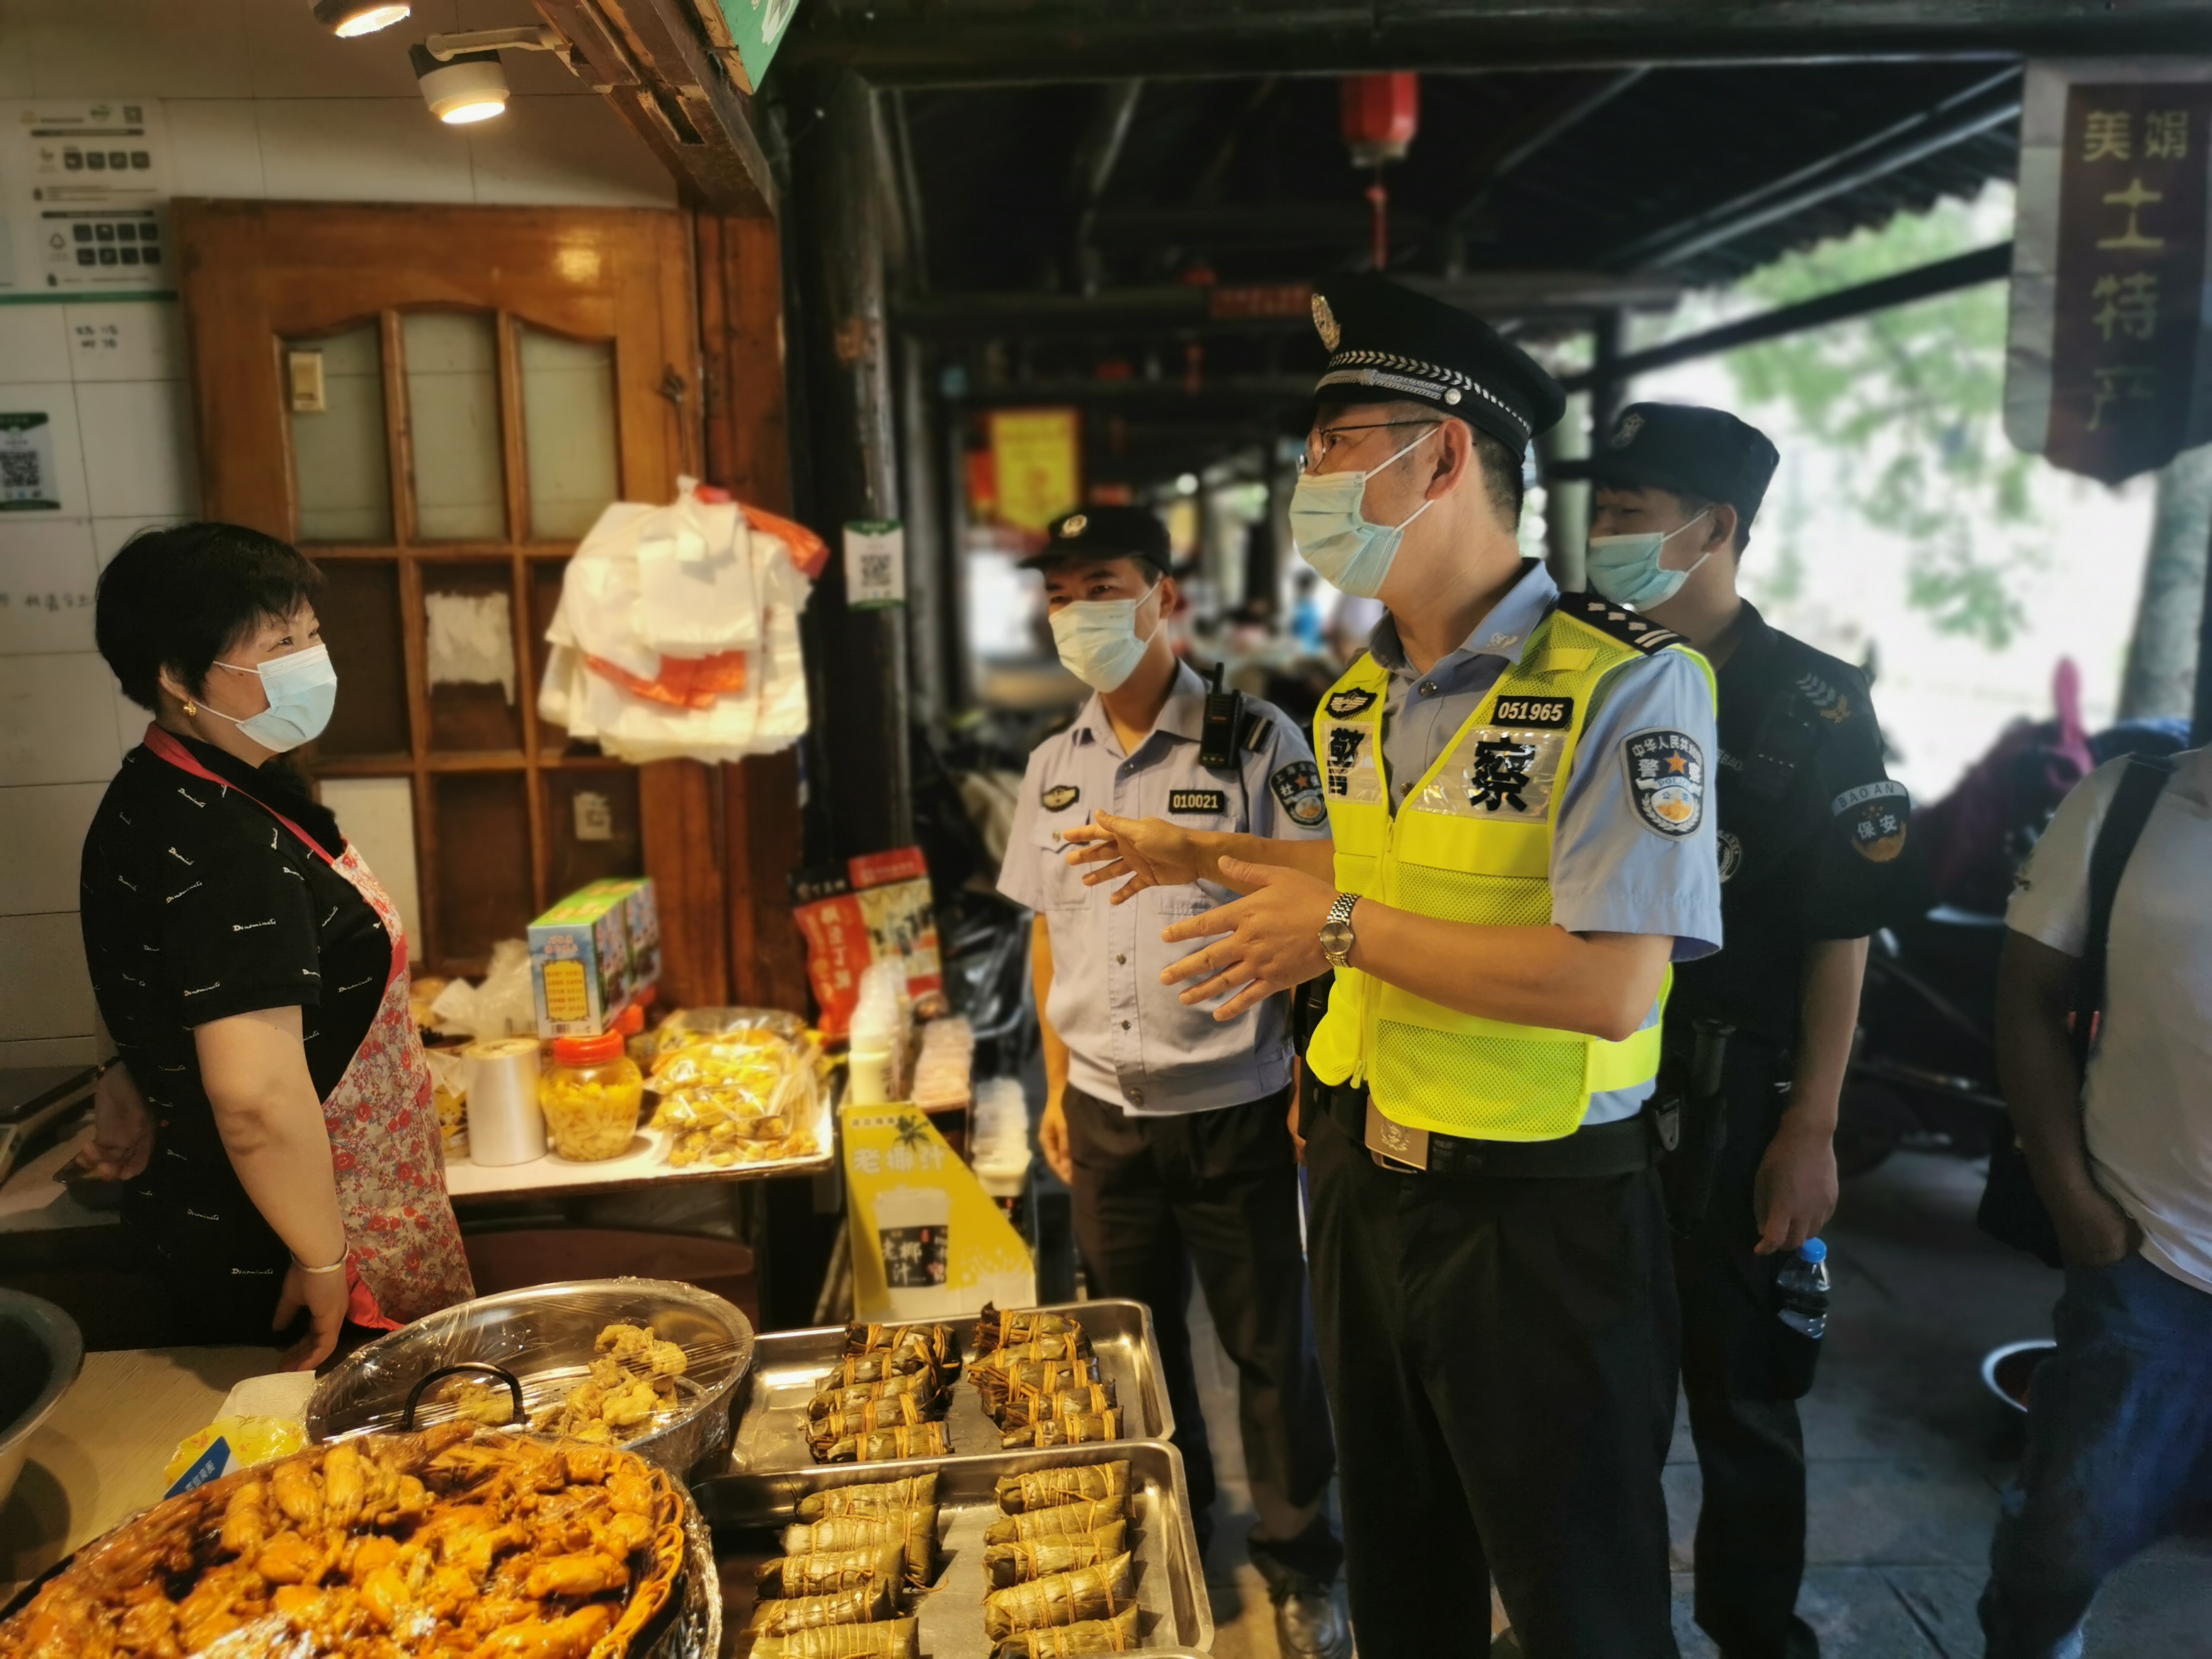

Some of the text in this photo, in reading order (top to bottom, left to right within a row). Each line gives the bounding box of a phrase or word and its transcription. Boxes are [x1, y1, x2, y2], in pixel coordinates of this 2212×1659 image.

[2083, 111, 2188, 162] 美娟
[2086, 178, 2164, 432] 土特产
[1498, 702, 1564, 722] 051965
[1470, 736, 1536, 811] 察
[1658, 777, 1692, 788] POLIC
[1173, 794, 1219, 808] 010021
[1857, 814, 1897, 840] 保安
